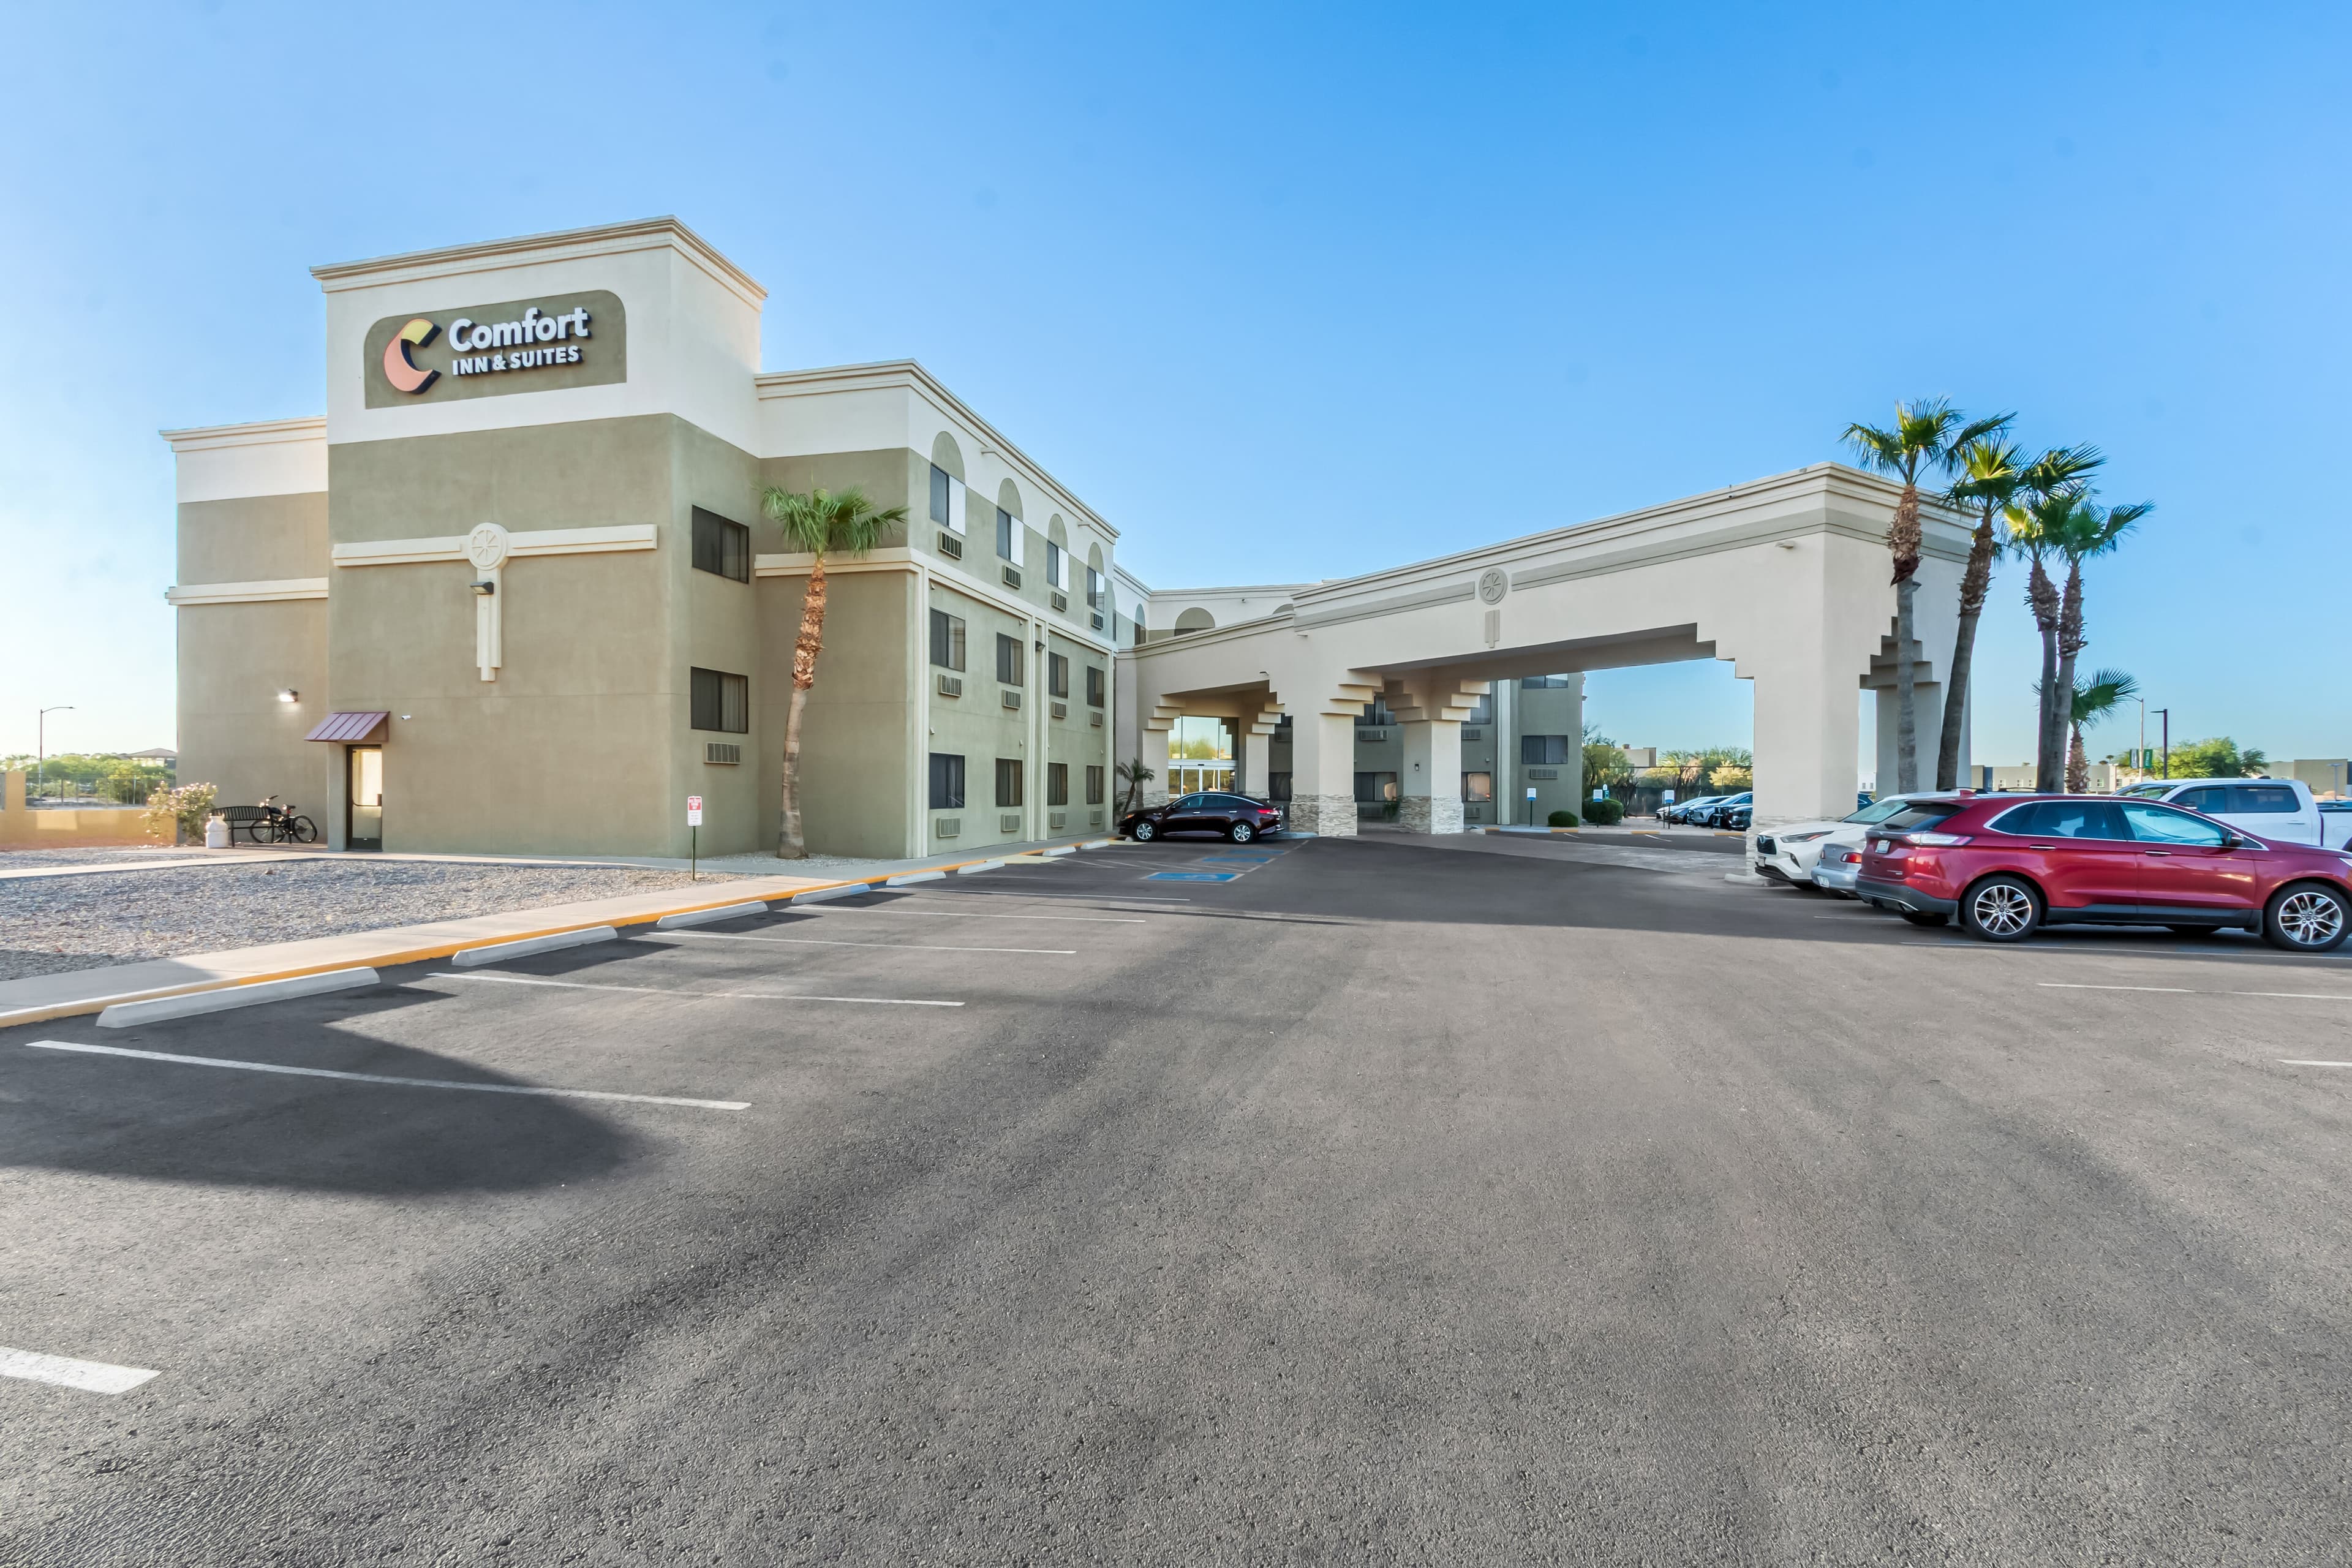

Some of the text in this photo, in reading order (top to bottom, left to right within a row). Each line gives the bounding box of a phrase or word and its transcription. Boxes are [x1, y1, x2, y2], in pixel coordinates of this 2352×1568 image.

[448, 307, 589, 352] Comfort
[452, 345, 580, 375] INN & SUITES
